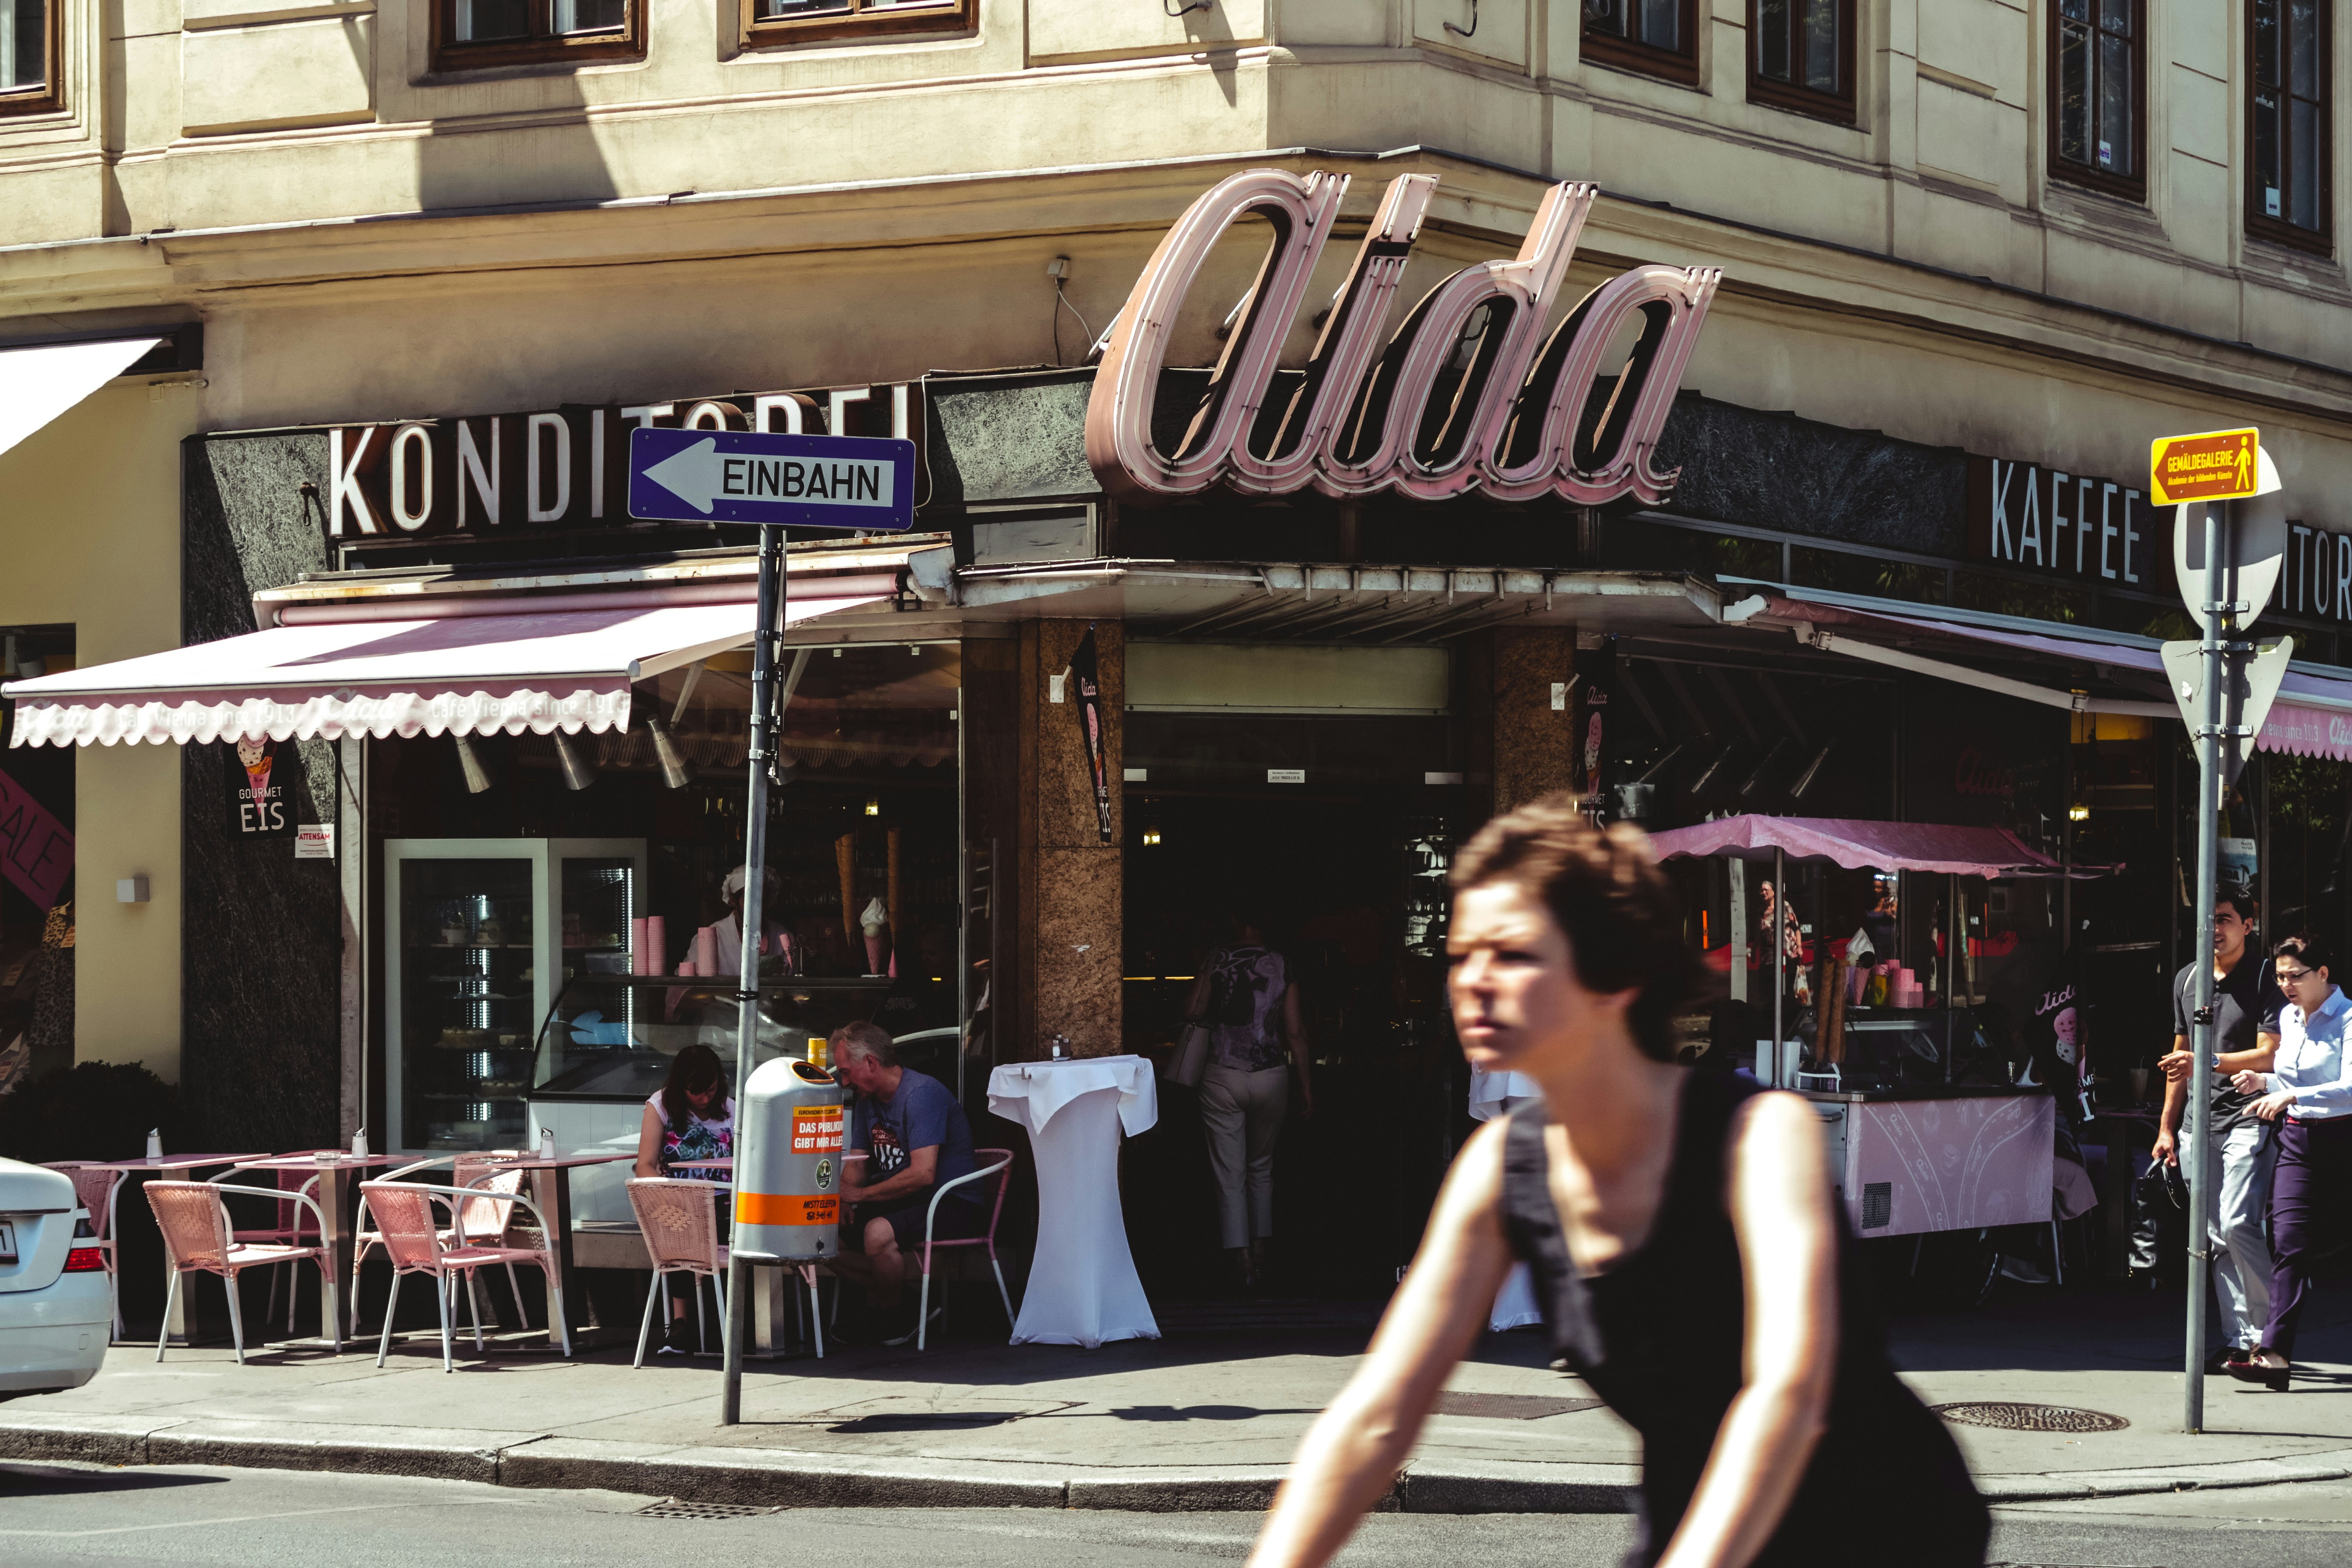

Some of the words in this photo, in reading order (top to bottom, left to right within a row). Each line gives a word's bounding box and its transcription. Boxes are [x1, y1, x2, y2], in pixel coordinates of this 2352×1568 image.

[1088, 168, 1725, 505] Aida
[2168, 450, 2233, 472] GEMÄLDEGALERIE
[723, 459, 879, 501] EINBAHN
[2168, 475, 2187, 486] Akademie
[2196, 472, 2216, 482] bildenden
[2217, 471, 2233, 480] Künste
[1992, 458, 2140, 583] KAFFEE
[1081, 676, 1096, 697] Aida
[1587, 685, 1608, 705] Aida
[154, 708, 206, 727] Vienna
[212, 706, 249, 725] since
[255, 704, 295, 724] 1913
[432, 696, 466, 719] Café
[472, 695, 527, 717] Vienna
[534, 693, 578, 716] since
[585, 692, 628, 714] 1913
[2285, 722, 2302, 740] since
[2304, 723, 2319, 742] 1913
[2329, 716, 2352, 746] Aid
[239, 786, 282, 799] GOURMET
[240, 802, 285, 832] EIS
[799, 1122, 816, 1133] DAS
[794, 1137, 815, 1148] GIBT
[816, 1137, 829, 1148] MIR
[803, 1199, 836, 1209] MISTTELEFON
